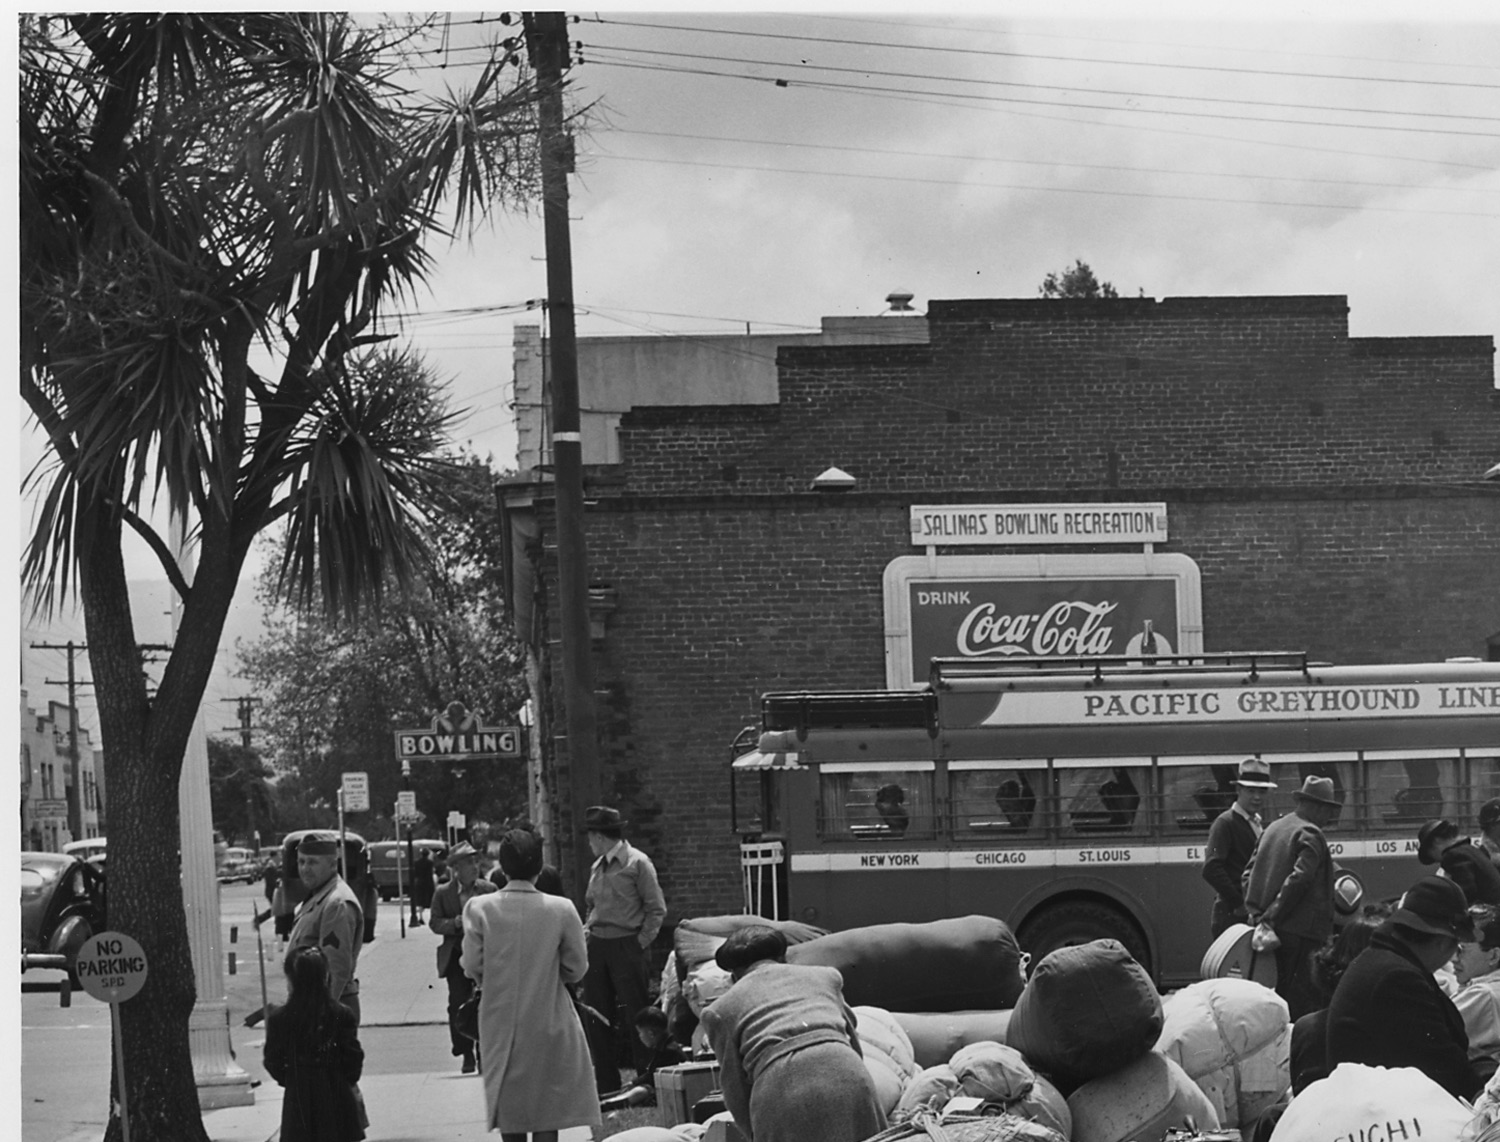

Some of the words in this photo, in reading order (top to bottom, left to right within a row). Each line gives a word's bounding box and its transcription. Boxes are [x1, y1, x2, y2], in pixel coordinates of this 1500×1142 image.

[923, 514, 988, 536] SALINAS
[994, 513, 1058, 535] BOWLING
[1064, 512, 1155, 534] RECREATION
[917, 591, 971, 605] DRINK
[956, 601, 1119, 656] Coca-Cola
[1084, 692, 1220, 717] PACIFIC
[1237, 687, 1420, 713] GREYHOUND
[401, 733, 514, 755] BOWLING
[1186, 847, 1201, 860] EL
[1376, 842, 1397, 853] LOS
[860, 855, 885, 867] NEW
[887, 854, 920, 866] YORK
[975, 852, 1026, 865] CHICAGO
[1079, 850, 1095, 863] ST.
[1097, 849, 1132, 862] LOUIS
[96, 939, 123, 956] NO
[78, 956, 145, 977] PARKING
